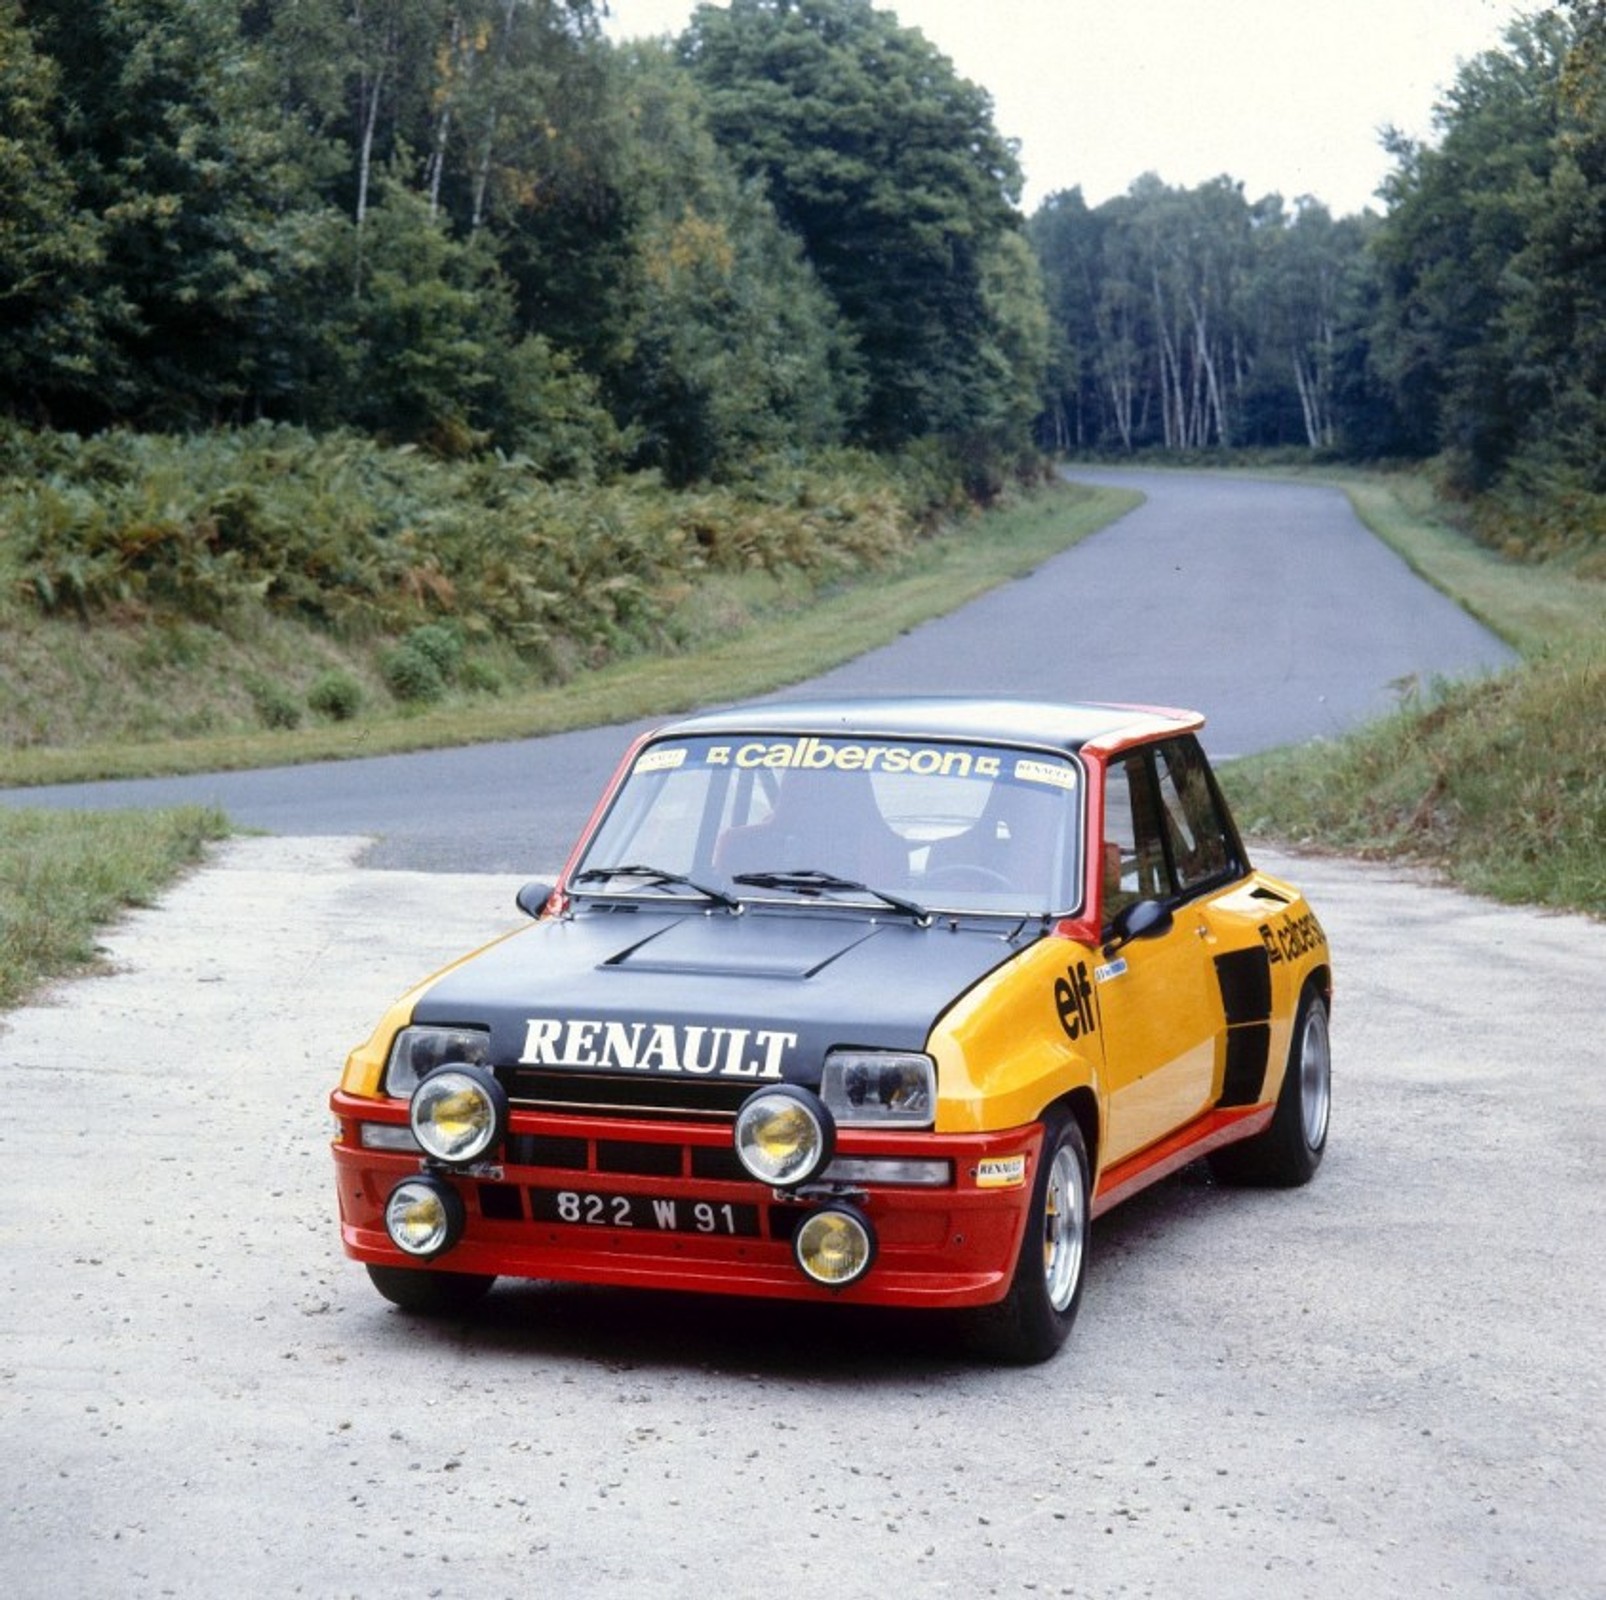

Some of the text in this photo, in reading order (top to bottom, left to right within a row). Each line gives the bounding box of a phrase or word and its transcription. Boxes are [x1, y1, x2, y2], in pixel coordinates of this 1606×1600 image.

[735, 737, 971, 776] calberson
[1054, 961, 1094, 1039] elf
[518, 1019, 797, 1077] RENAULT
[557, 1191, 736, 1234] 822 W 91
